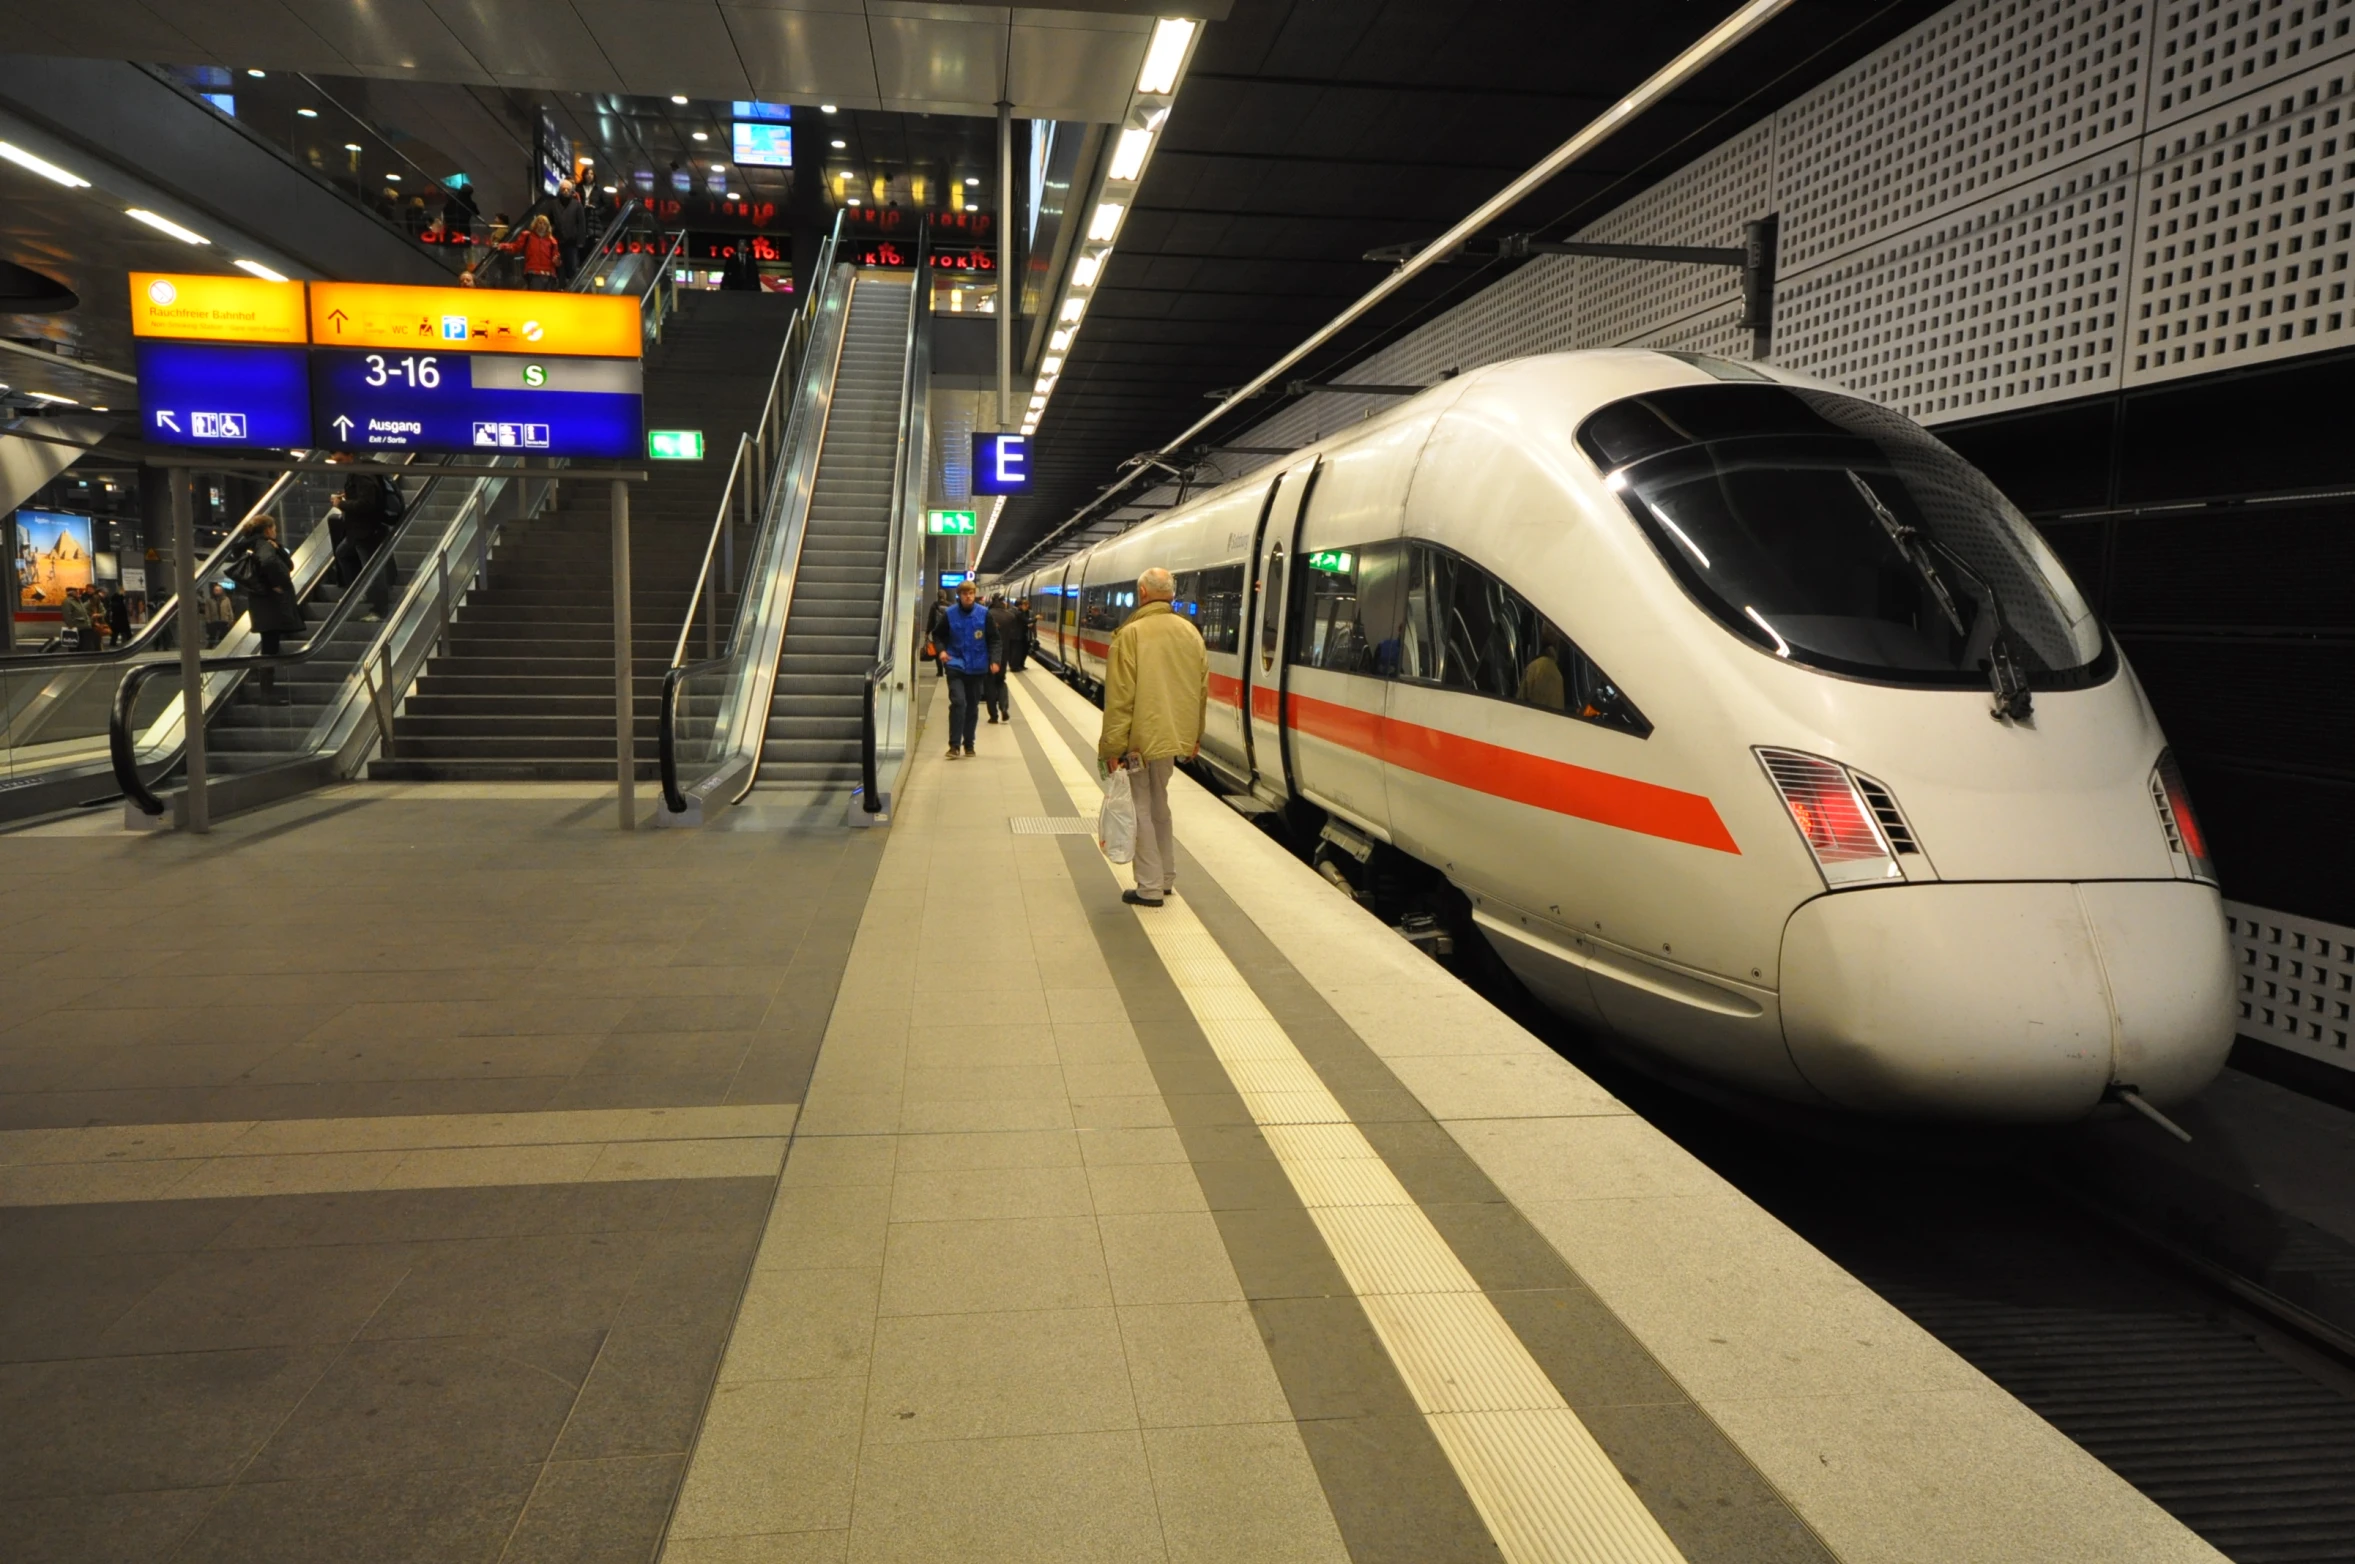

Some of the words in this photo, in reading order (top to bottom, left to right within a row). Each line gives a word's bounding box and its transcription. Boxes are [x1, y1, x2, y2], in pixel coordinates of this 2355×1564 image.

[709, 245, 775, 259] TOIO
[149, 306, 210, 319] Rauchfreier
[212, 309, 256, 321] Bahnhof
[392, 325, 409, 335] WC
[365, 354, 441, 388] 3-16
[525, 365, 545, 387] S
[368, 419, 421, 434] Ausgang
[369, 436, 381, 444] Exit
[387, 436, 407, 444] Sortie
[996, 435, 1025, 482] E
[966, 570, 976, 582] D
